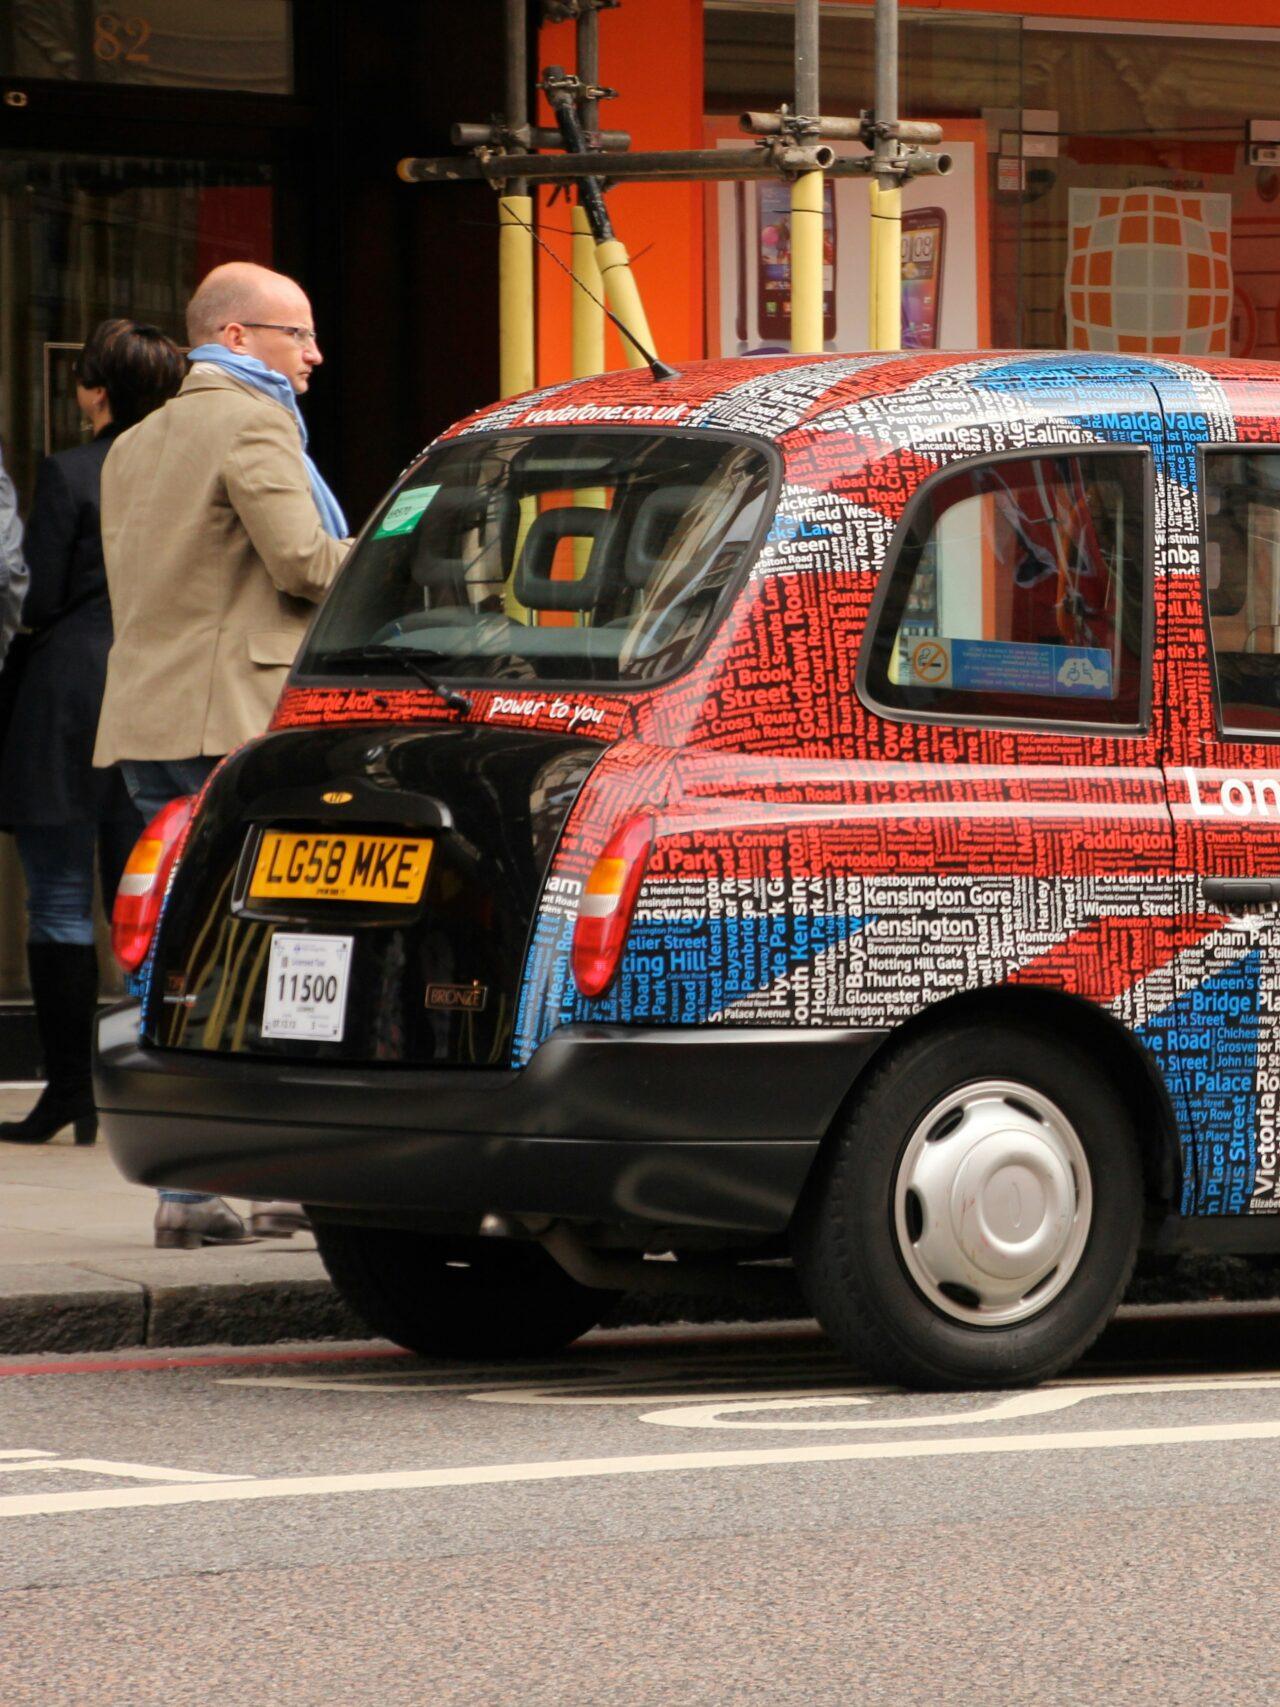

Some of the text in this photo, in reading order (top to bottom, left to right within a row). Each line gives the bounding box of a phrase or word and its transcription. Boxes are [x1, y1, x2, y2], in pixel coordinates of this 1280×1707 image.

[94, 15, 150, 63] 82
[524, 402, 690, 424] vodafone.co.uk
[1103, 413, 1208, 431] Maida Vale
[909, 425, 982, 444] Barnes
[1024, 426, 1081, 444] Ealing
[914, 442, 982, 452] Lancaster Place
[775, 505, 884, 526] Fairfield West
[778, 538, 830, 554] Green
[783, 574, 815, 740] Goldhawk Road
[489, 697, 605, 727] power to you
[669, 684, 790, 728] King Street
[266, 839, 419, 890] LG58 MKE
[822, 852, 934, 867] Portobello Road
[863, 875, 973, 887] Westbourne Grove
[788, 829, 809, 960] Kensington
[864, 886, 1012, 910] Kensington Gore
[721, 850, 742, 991] Bayswater Road
[1084, 902, 1180, 920] Wigmore Street
[845, 874, 867, 988] Bayswater
[864, 915, 974, 941] Kensington
[664, 936, 708, 949] Street
[1154, 929, 1246, 949] Buckingham
[867, 943, 961, 957] Brompton Oratory
[671, 952, 707, 971] Hill
[868, 957, 964, 971] Notting Hill Gate
[278, 973, 338, 1004] 11500
[864, 972, 964, 988] Thurloe Place
[1175, 975, 1199, 990] The
[1201, 975, 1254, 991] Queen's
[431, 988, 480, 1006] BRONZE
[1193, 992, 1253, 1016] Bridge
[826, 1004, 916, 1019] Kensington Park
[1167, 1030, 1211, 1051] Road
[1217, 1042, 1273, 1053] Grosvenor
[1195, 1073, 1251, 1092] Palace
[1253, 1093, 1276, 1196] Victoria
